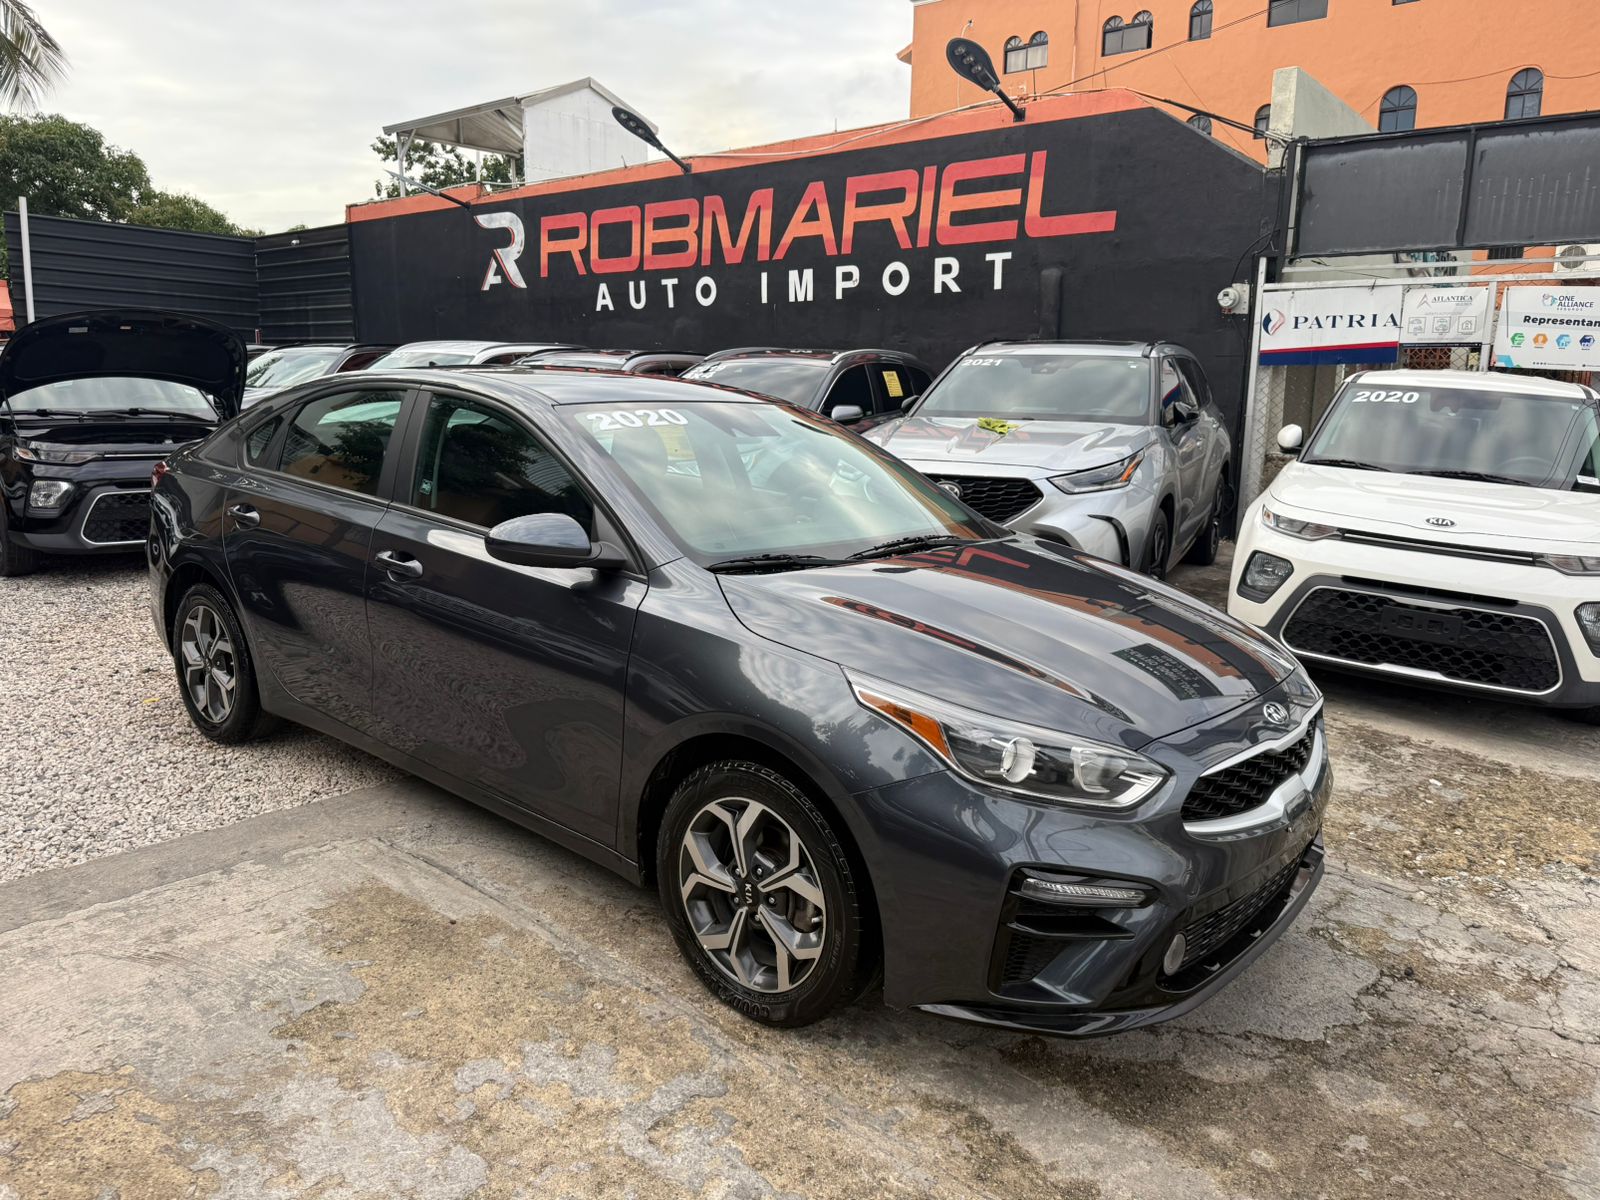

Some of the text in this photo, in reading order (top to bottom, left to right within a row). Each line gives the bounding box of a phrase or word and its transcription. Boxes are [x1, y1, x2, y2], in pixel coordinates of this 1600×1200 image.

[539, 150, 1117, 278] ROBMARIEL
[595, 251, 1012, 312] AUTO IMPORT
[1293, 312, 1400, 330] PATRIA
[961, 358, 1004, 367] 2021
[1352, 390, 1420, 404] 2020
[586, 408, 689, 431] 2020
[1429, 518, 1451, 527] KIA
[744, 883, 753, 904] KIA
